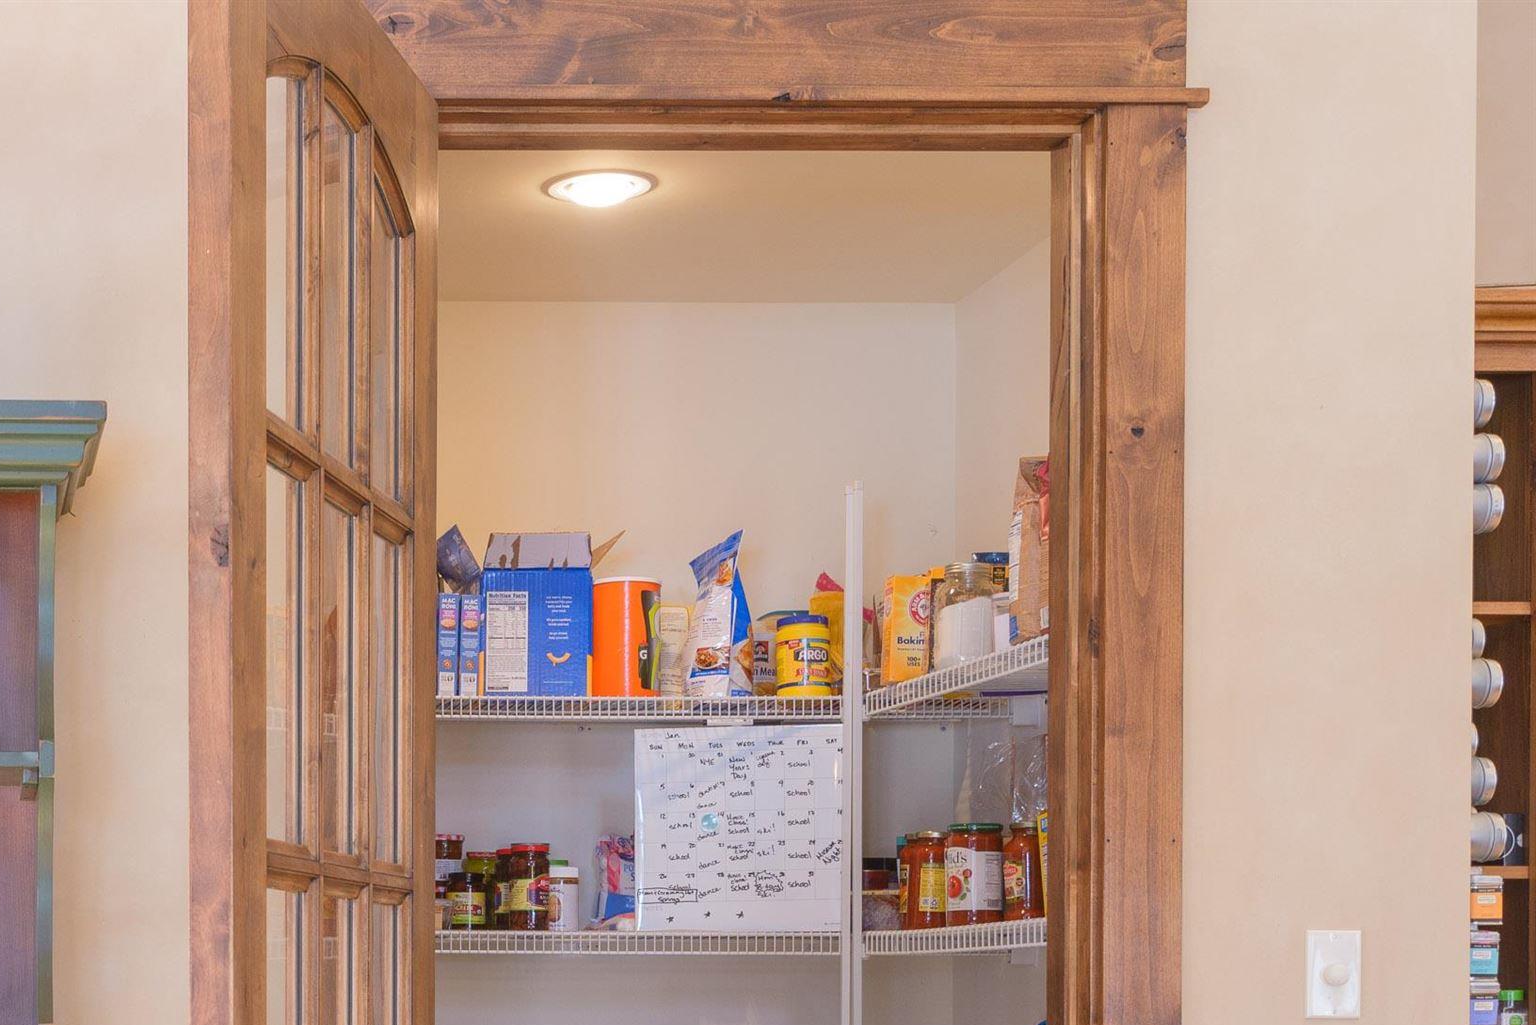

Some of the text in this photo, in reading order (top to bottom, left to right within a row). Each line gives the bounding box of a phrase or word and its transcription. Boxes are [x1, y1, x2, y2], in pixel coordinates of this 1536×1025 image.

[897, 636, 925, 645] Bakin
[639, 649, 647, 660] G
[797, 649, 827, 661] ARGO
[760, 666, 776, 676] Mea
